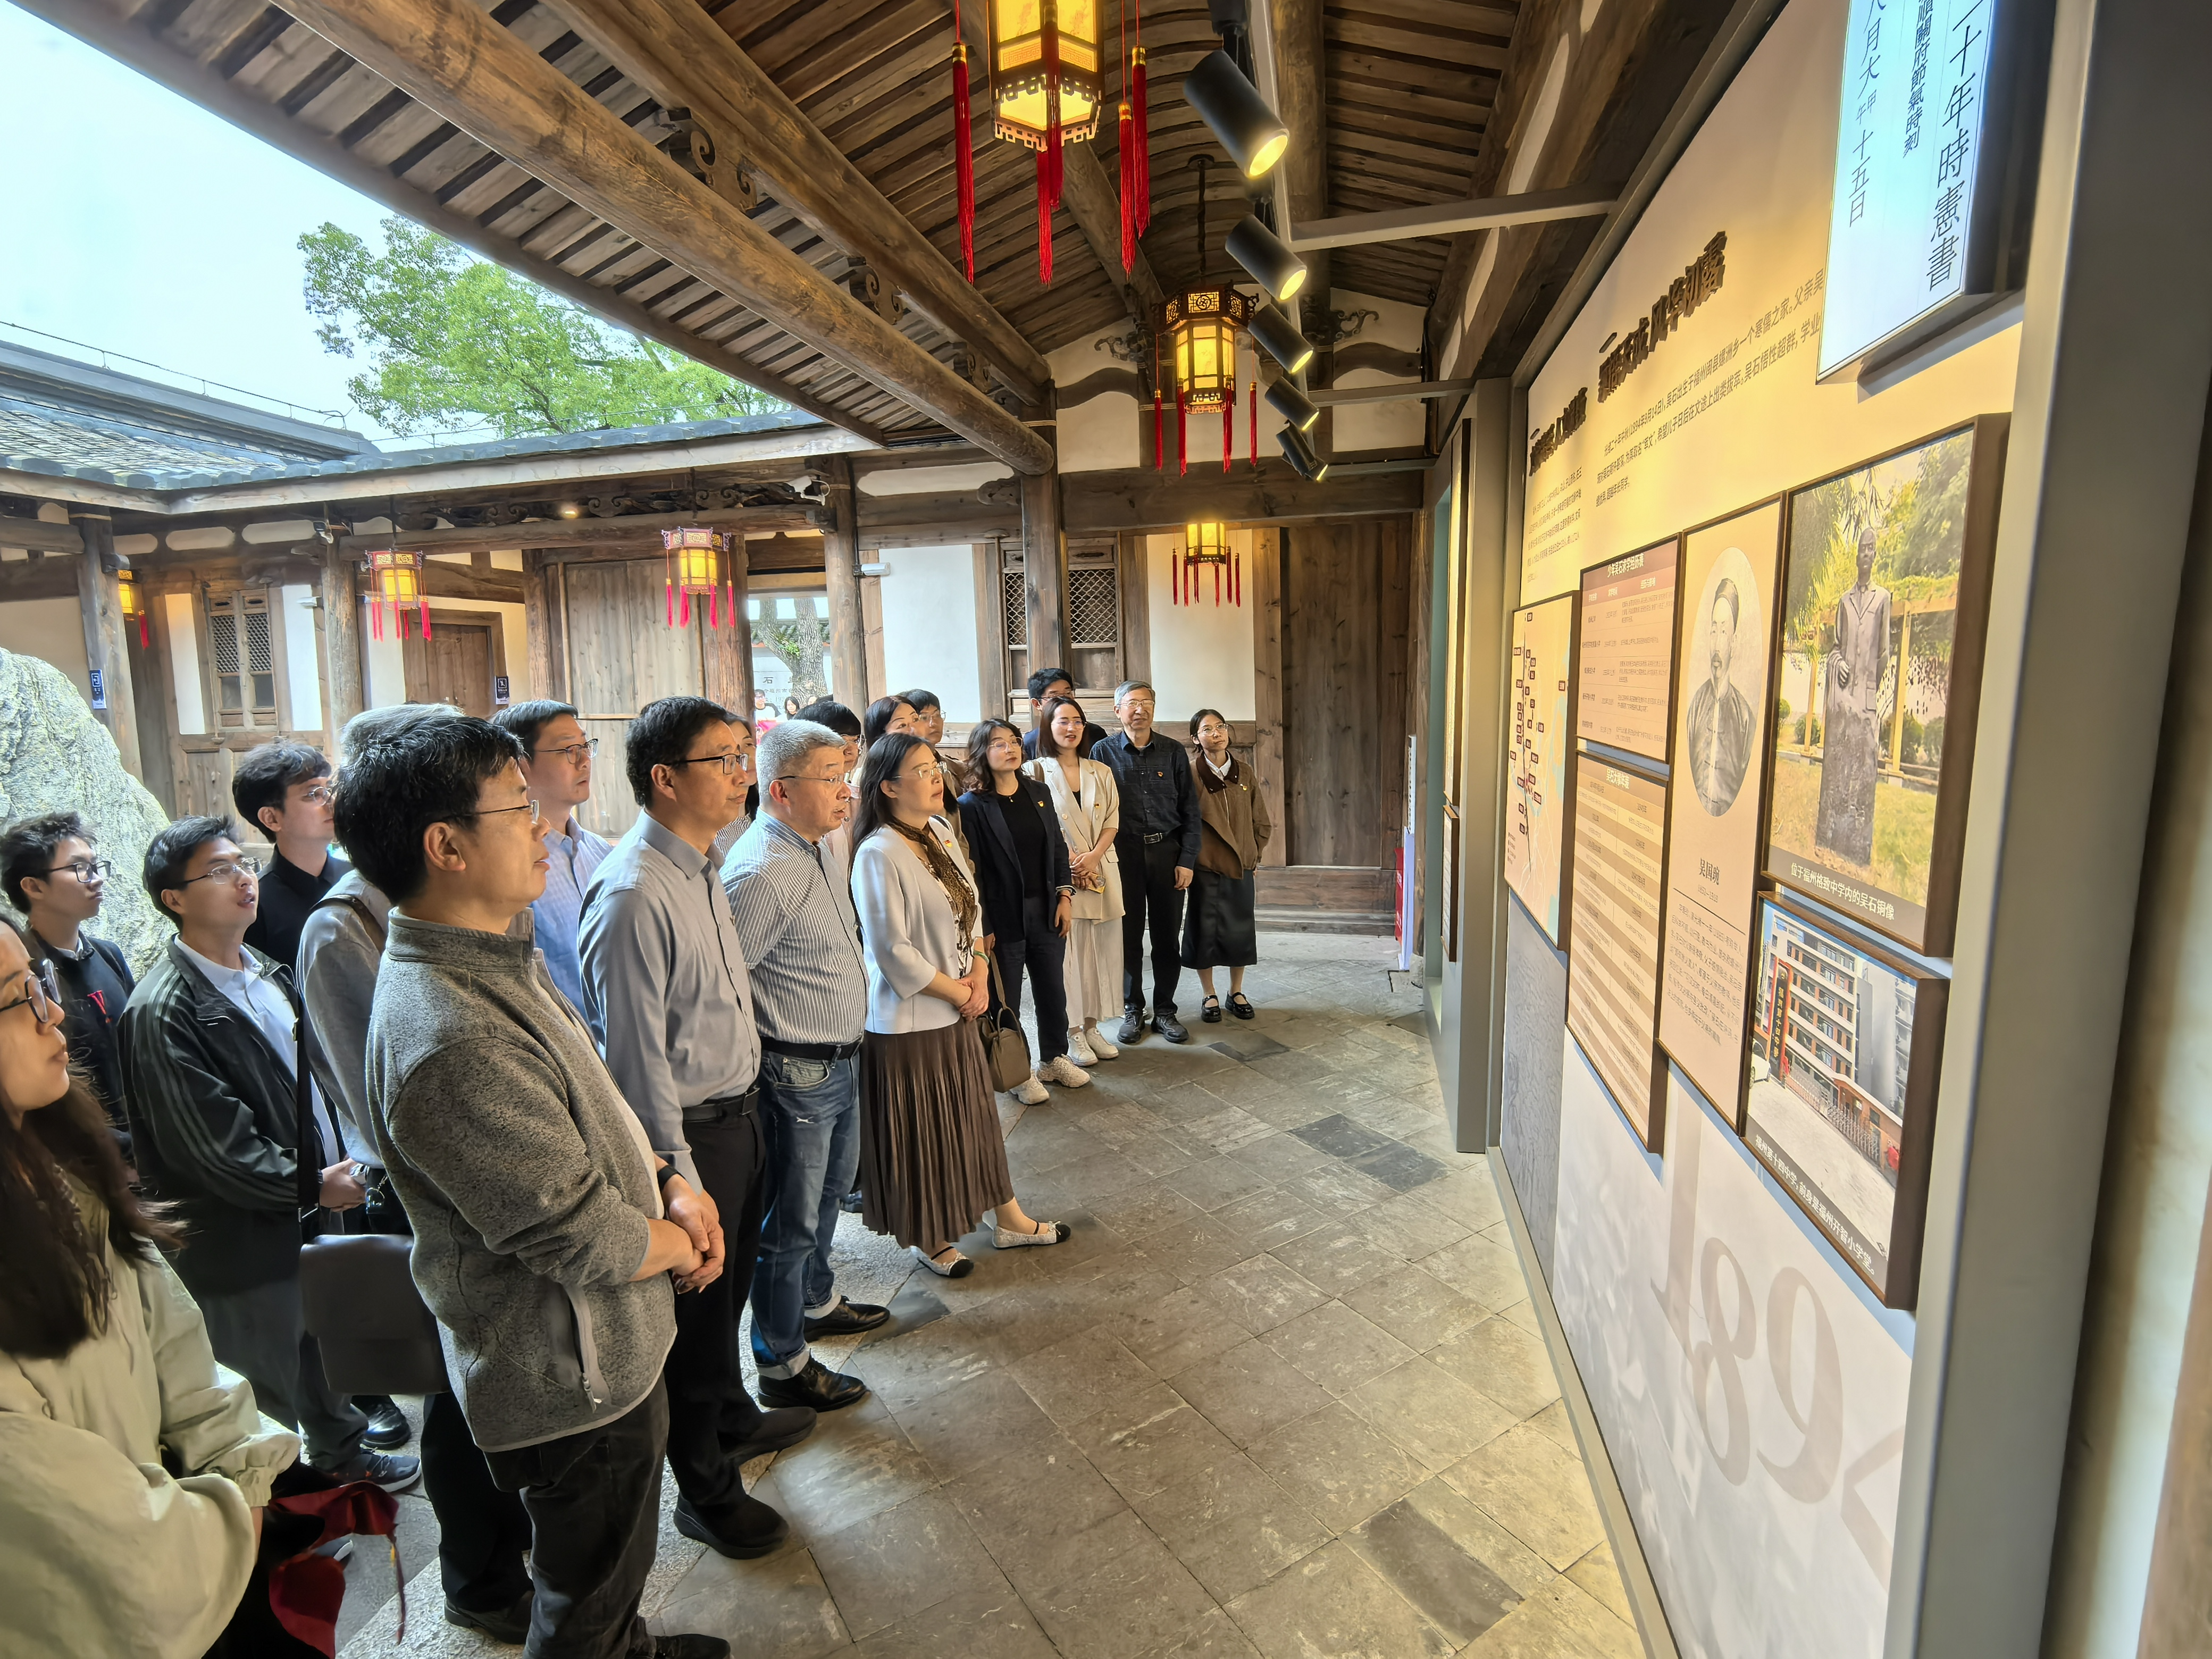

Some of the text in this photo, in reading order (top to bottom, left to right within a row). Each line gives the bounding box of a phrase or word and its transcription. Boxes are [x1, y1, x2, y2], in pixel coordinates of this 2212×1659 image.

[1791, 862, 1895, 920] 位于福州格致中学内的吴石铜像
